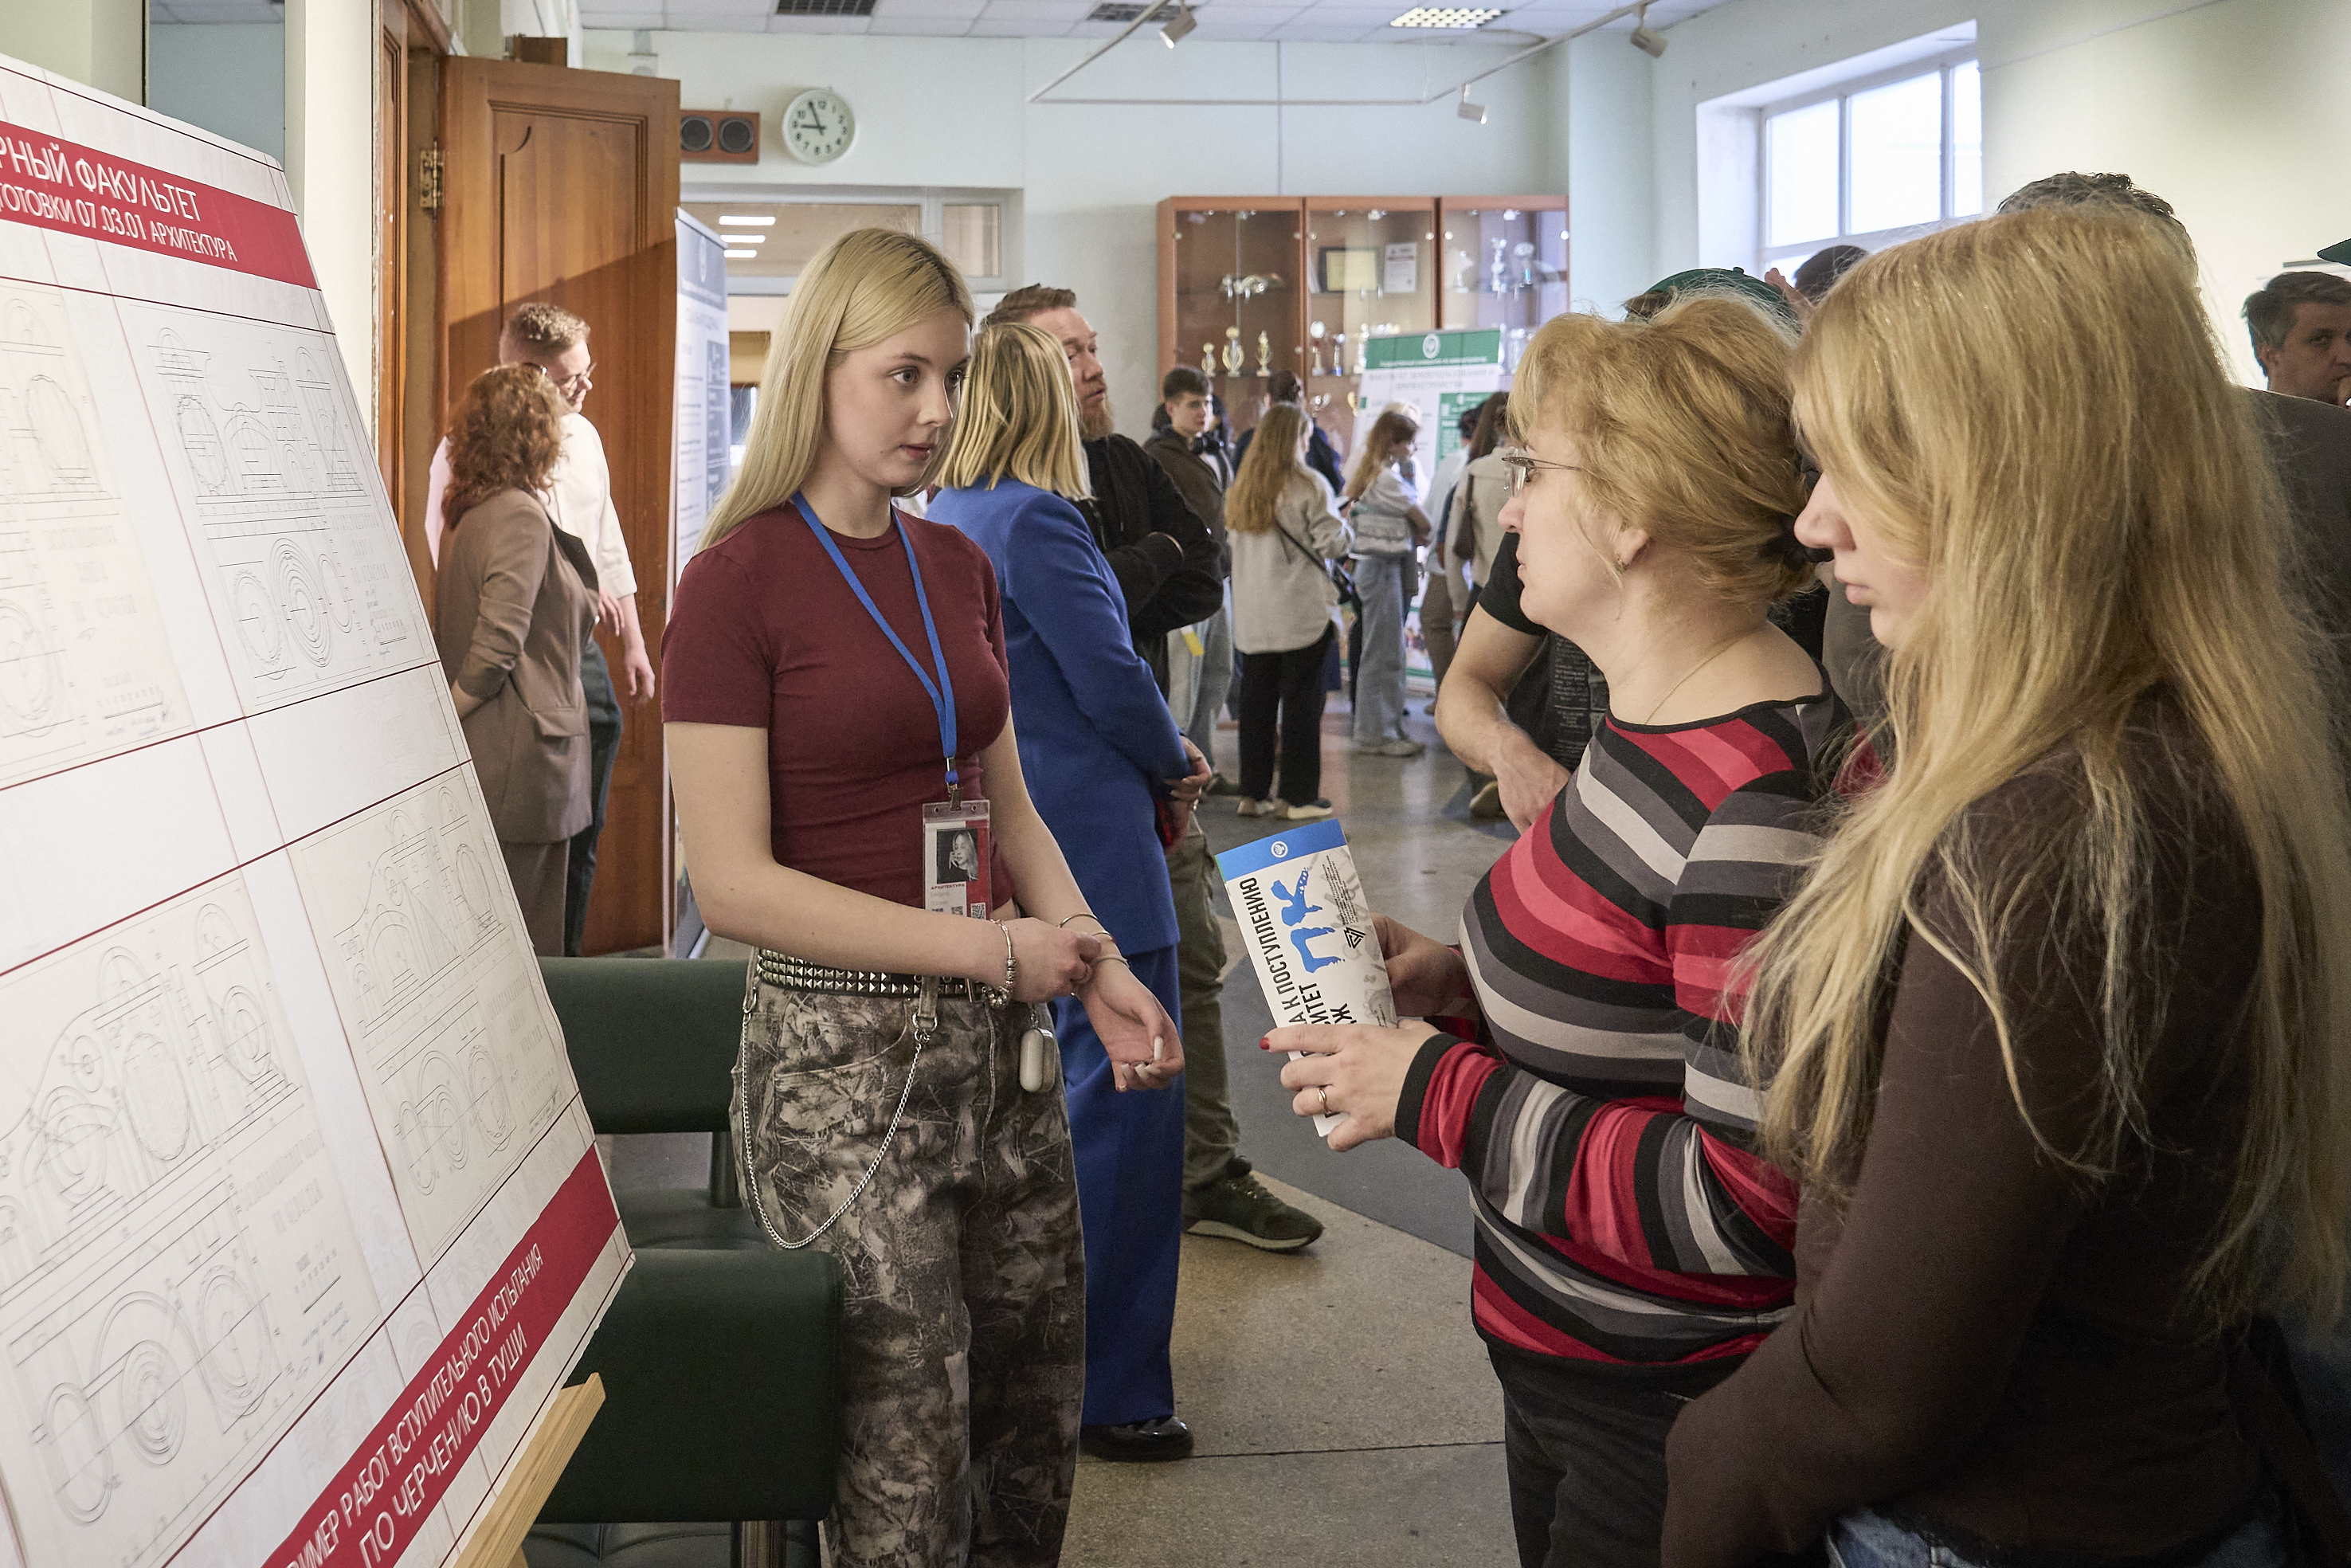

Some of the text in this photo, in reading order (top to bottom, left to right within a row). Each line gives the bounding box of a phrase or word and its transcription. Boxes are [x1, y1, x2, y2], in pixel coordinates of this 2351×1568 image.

[75, 158, 200, 221] ФАКУЛЬТЕТ
[150, 220, 237, 262] АРХИТЕКТУРА
[1239, 877, 1295, 994] ПОСТУПЛЕНИЮ
[1281, 995, 1300, 1010] К
[1298, 982, 1330, 1024] ИТЕТ
[339, 1445, 390, 1528] РАБОТ
[387, 1316, 490, 1466] ВСТУПИТЕЛЬНОГО
[488, 1243, 543, 1331] ИСПЫТАНИЯ
[359, 1322, 527, 1568] ПО ЧЕРЧЕНИЮ В ТУШИ
